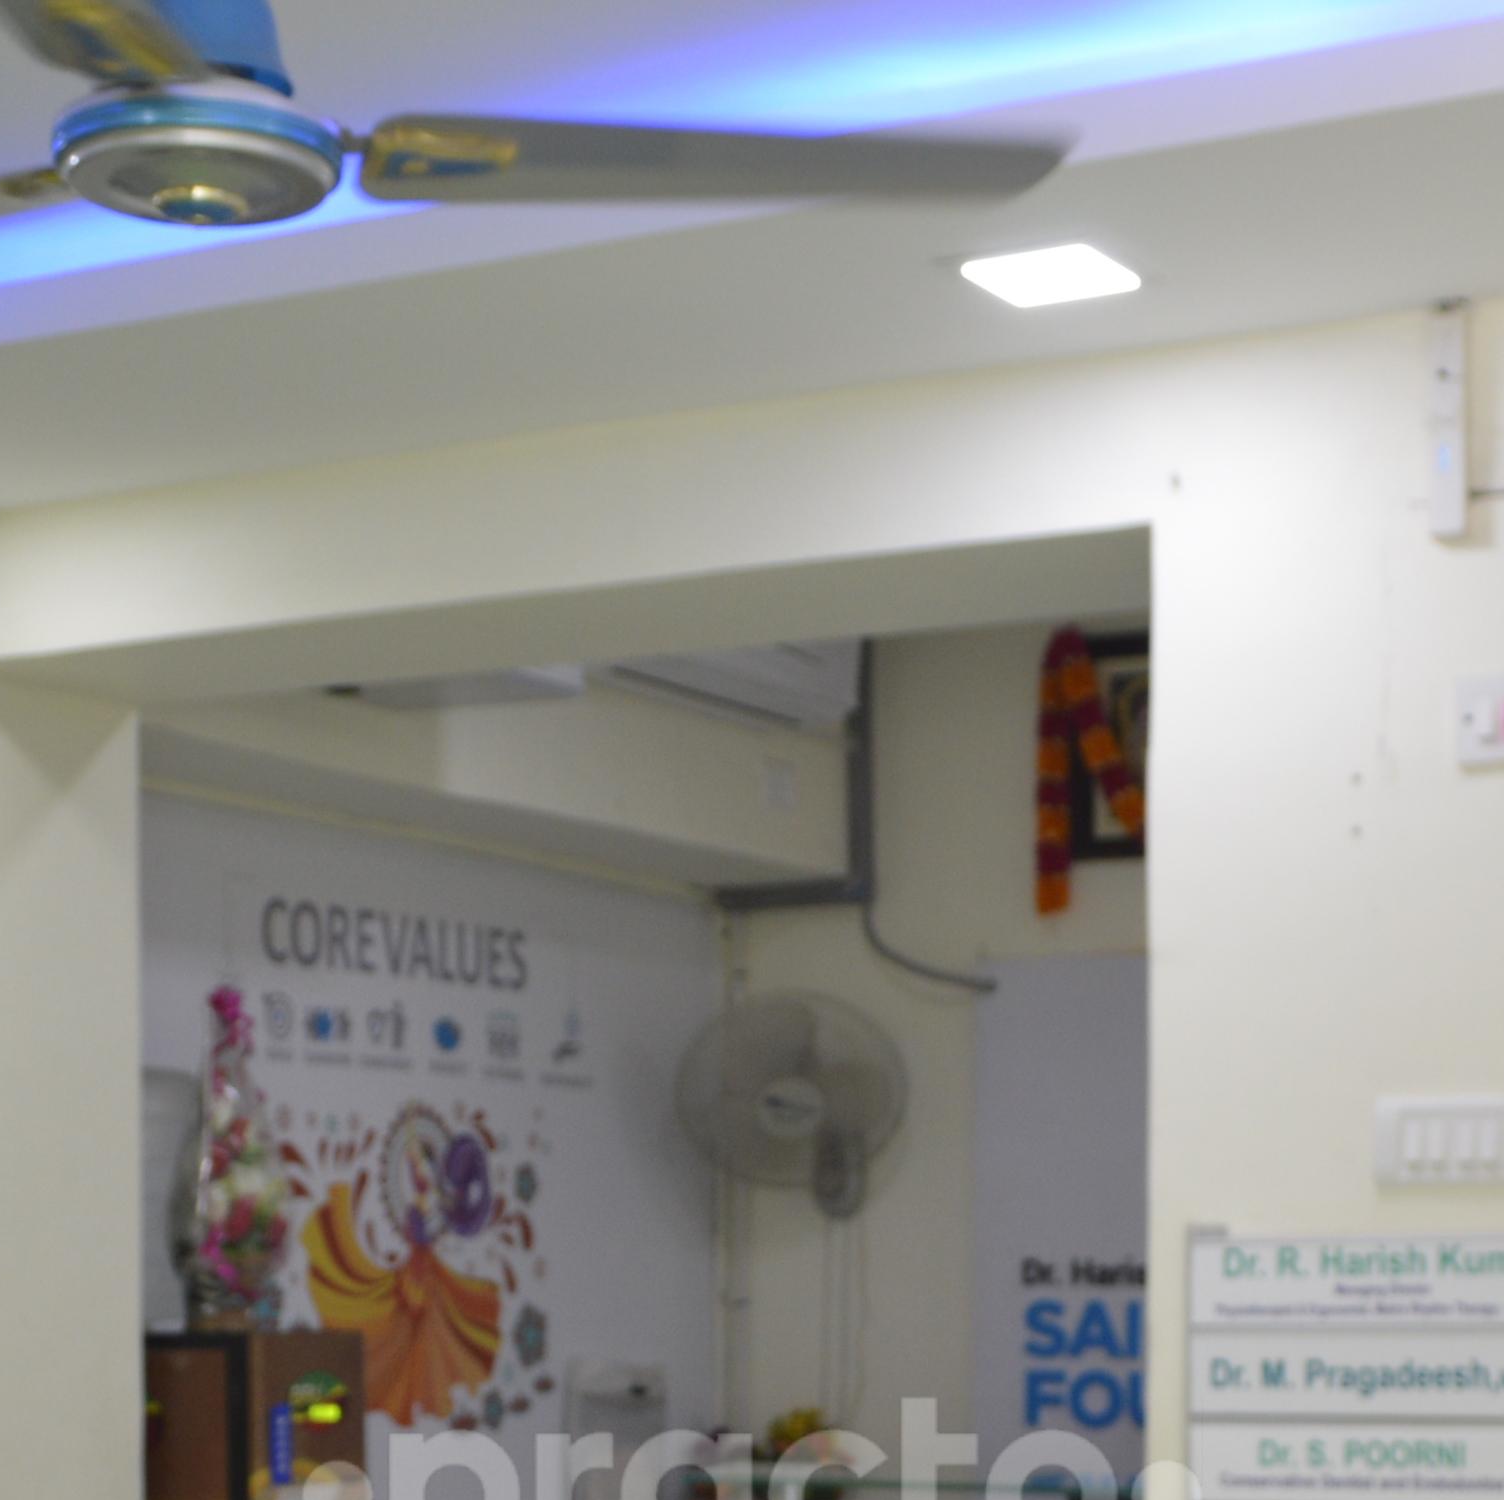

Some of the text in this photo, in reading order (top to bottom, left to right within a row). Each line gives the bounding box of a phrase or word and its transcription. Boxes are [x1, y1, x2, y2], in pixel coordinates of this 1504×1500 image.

[262, 894, 529, 991] COREVALUES
[1022, 1256, 1061, 1285] Dr.
[1222, 1246, 1264, 1278] Dr.
[1276, 1246, 1307, 1277] R.
[1320, 1245, 1427, 1277] Harish
[1025, 1298, 1142, 1358] SAI
[1209, 1357, 1250, 1389] Dr.
[1261, 1359, 1294, 1390] M.
[1257, 1439, 1468, 1468] Dr. S. POORNI
